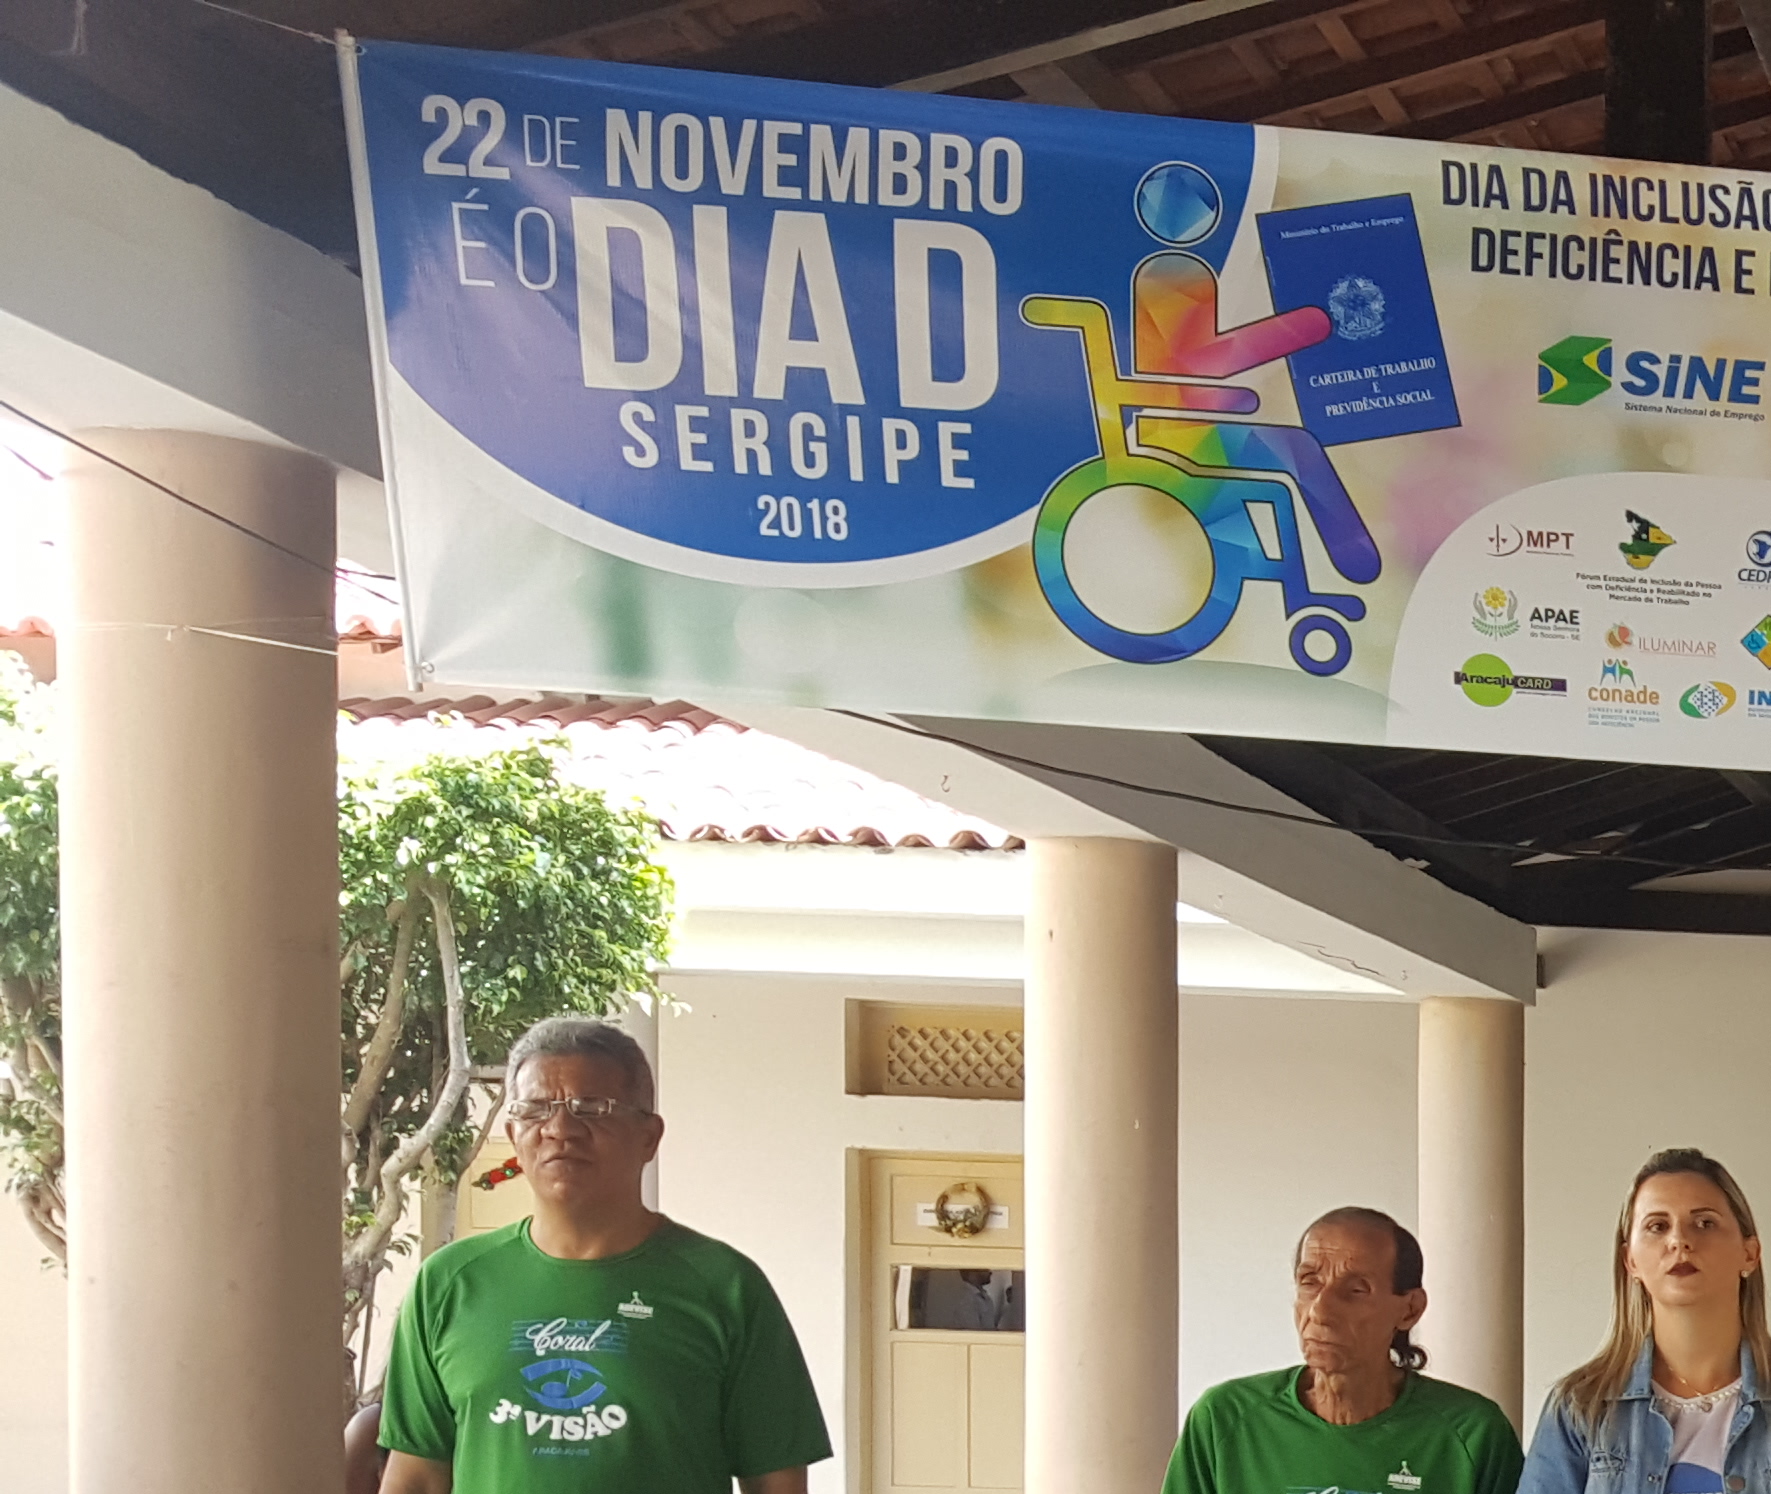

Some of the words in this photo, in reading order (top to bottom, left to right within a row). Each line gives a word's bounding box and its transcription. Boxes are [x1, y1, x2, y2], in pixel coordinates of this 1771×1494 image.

[422, 95, 511, 181] 22
[522, 113, 582, 170] DE
[605, 107, 1024, 216] NOVEMBRO
[1440, 159, 1510, 211] DIA
[1520, 166, 1577, 216] DA
[1470, 225, 1721, 293] DEFICIÊNCIA
[1732, 248, 1756, 296] E
[450, 187, 497, 288] É
[513, 206, 559, 292] O
[570, 196, 867, 406] DIA
[893, 217, 1000, 412] D
[618, 400, 976, 490] SERGIPE
[756, 494, 850, 541] 2018
[1526, 529, 1575, 549] MPT
[1529, 606, 1581, 625] APAE
[1638, 636, 1717, 655] ILUMINAR
[1460, 670, 1516, 689] Aracaju
[1517, 677, 1553, 690] CARD
[1587, 685, 1660, 706] conade
[525, 1317, 613, 1357] Coral
[524, 1404, 628, 1442] VISÃO
